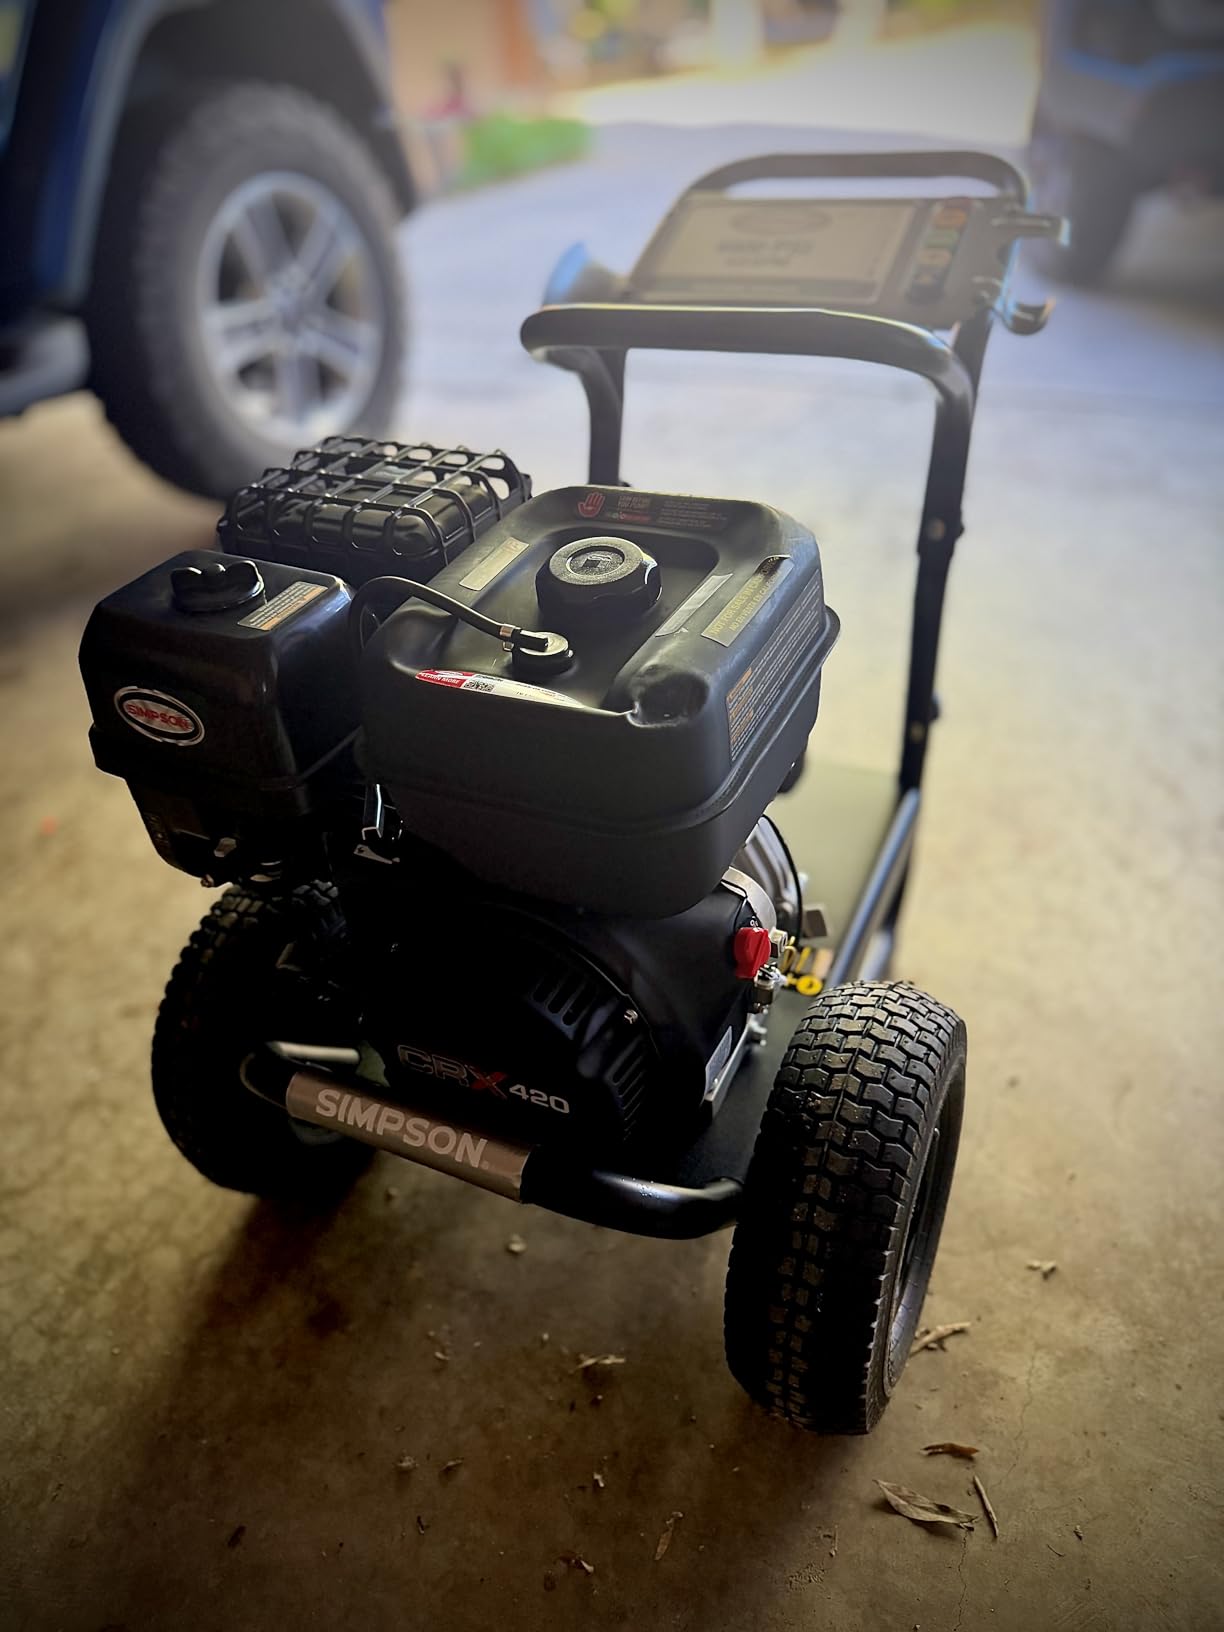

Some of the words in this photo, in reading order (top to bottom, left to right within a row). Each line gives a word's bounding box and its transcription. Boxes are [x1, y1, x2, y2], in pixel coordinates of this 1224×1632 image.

[709, 620, 726, 636] NOT
[720, 607, 736, 622] FOR
[731, 593, 748, 610] SALE
[441, 677, 460, 685] MORE
[398, 1045, 507, 1098] CRX
[509, 1084, 570, 1114] 420
[315, 1088, 488, 1168] SIMPSON
